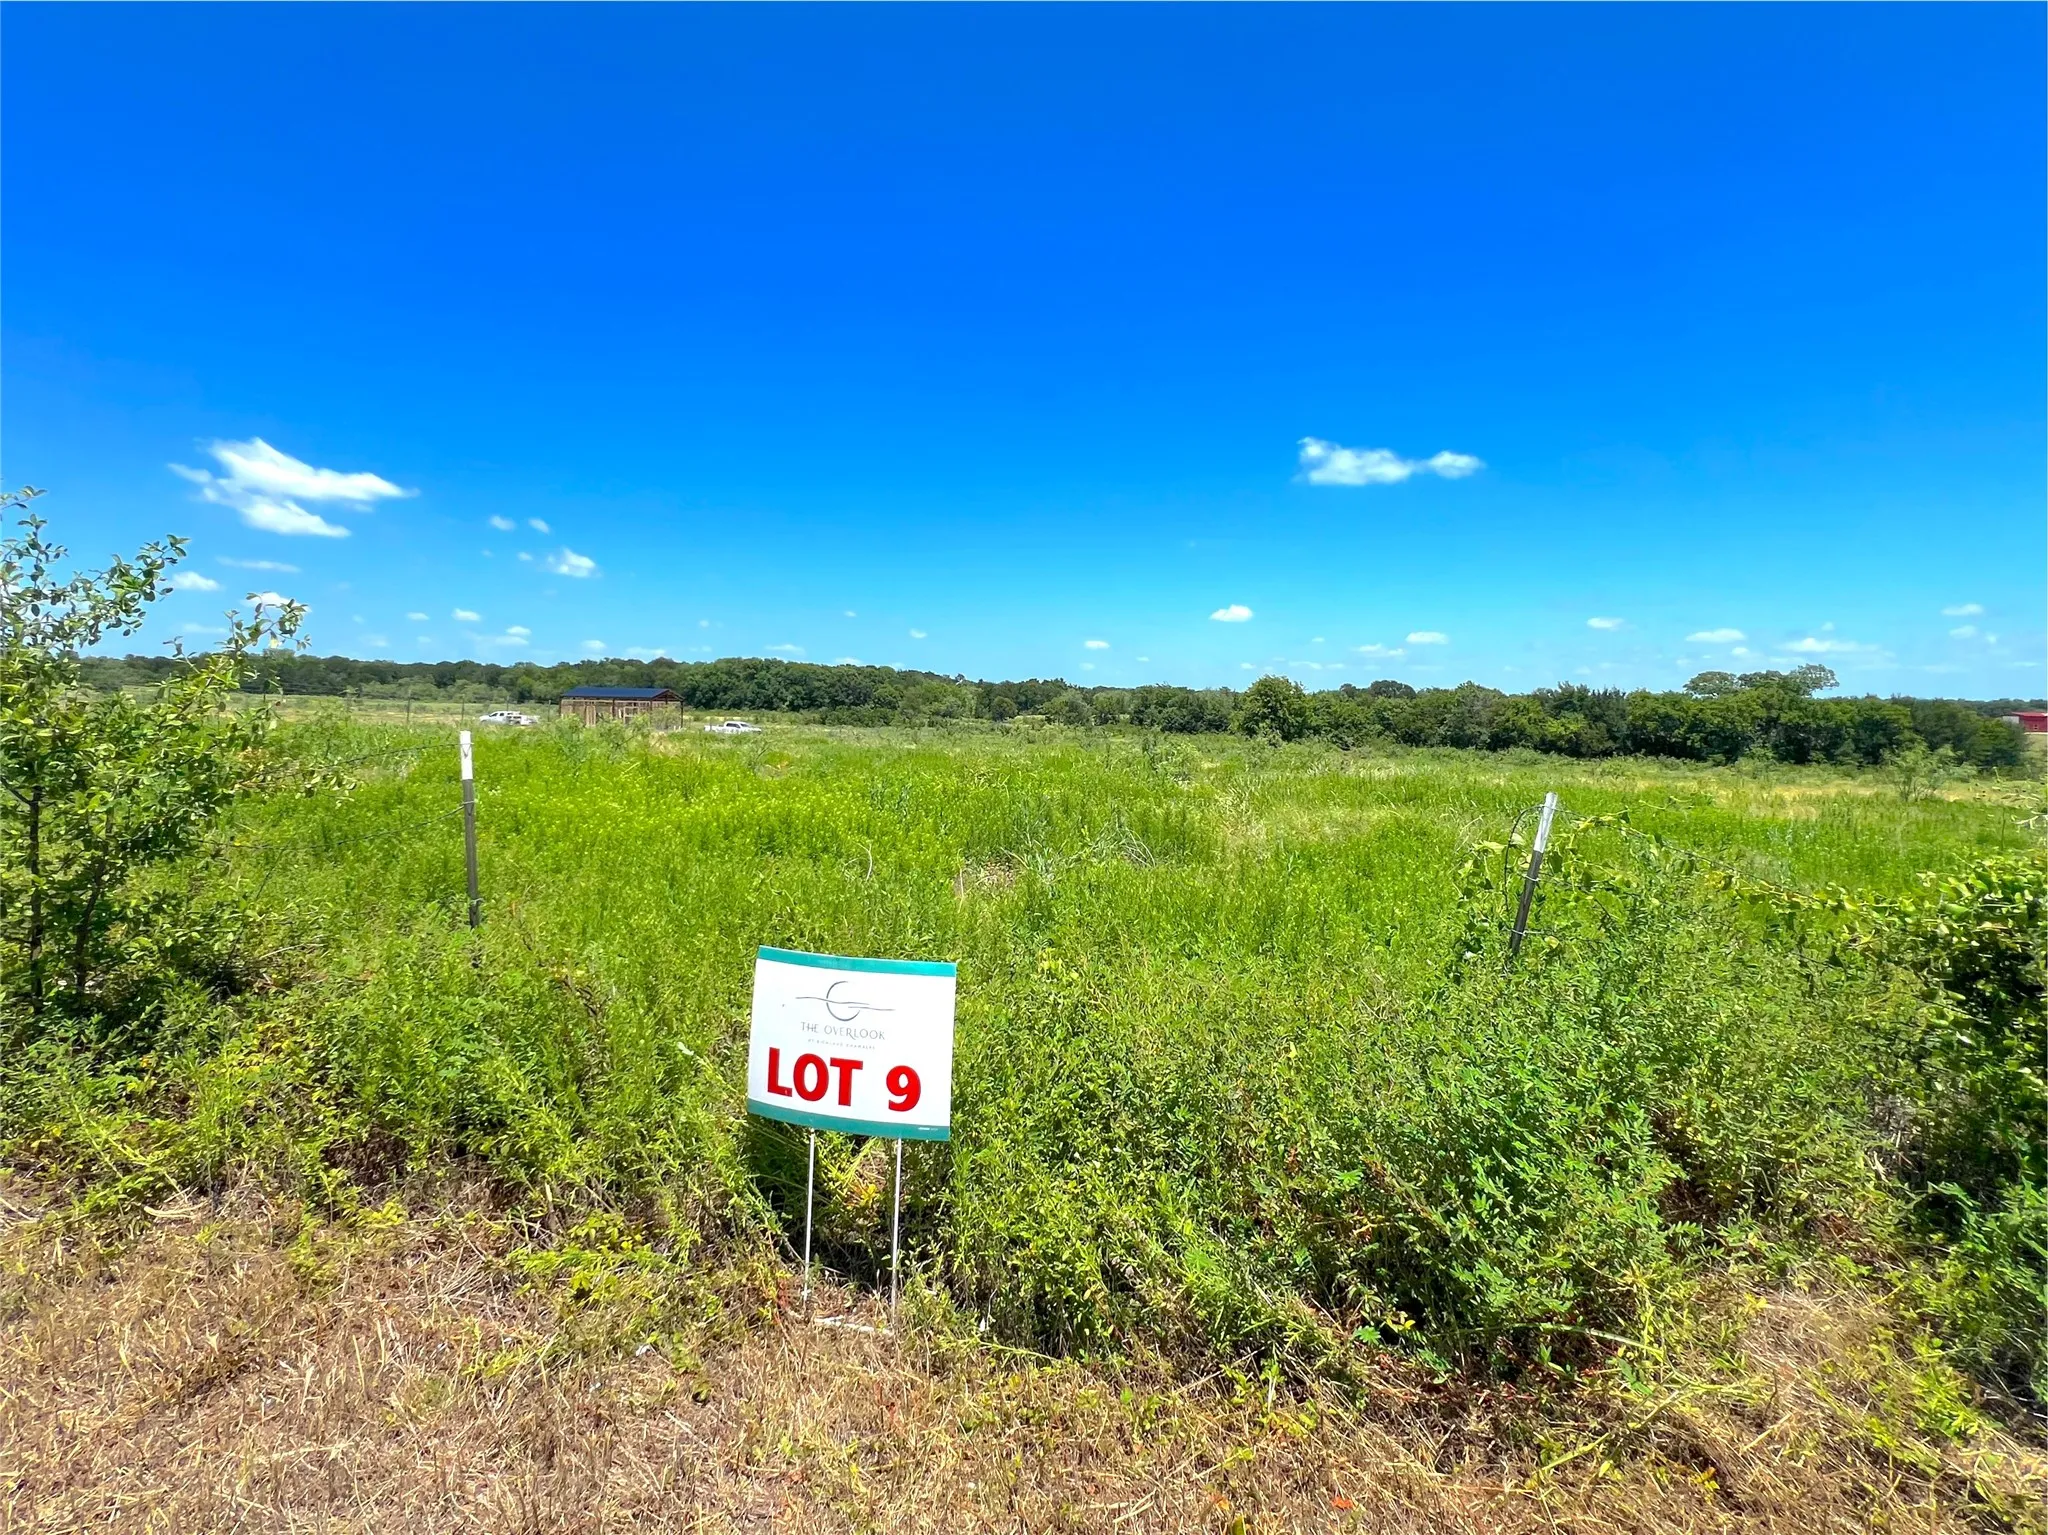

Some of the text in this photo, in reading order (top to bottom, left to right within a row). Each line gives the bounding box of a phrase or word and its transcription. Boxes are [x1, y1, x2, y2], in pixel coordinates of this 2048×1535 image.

[800, 1021, 885, 1040] THE OVERLOOK
[767, 1047, 921, 1112] LOT 9
